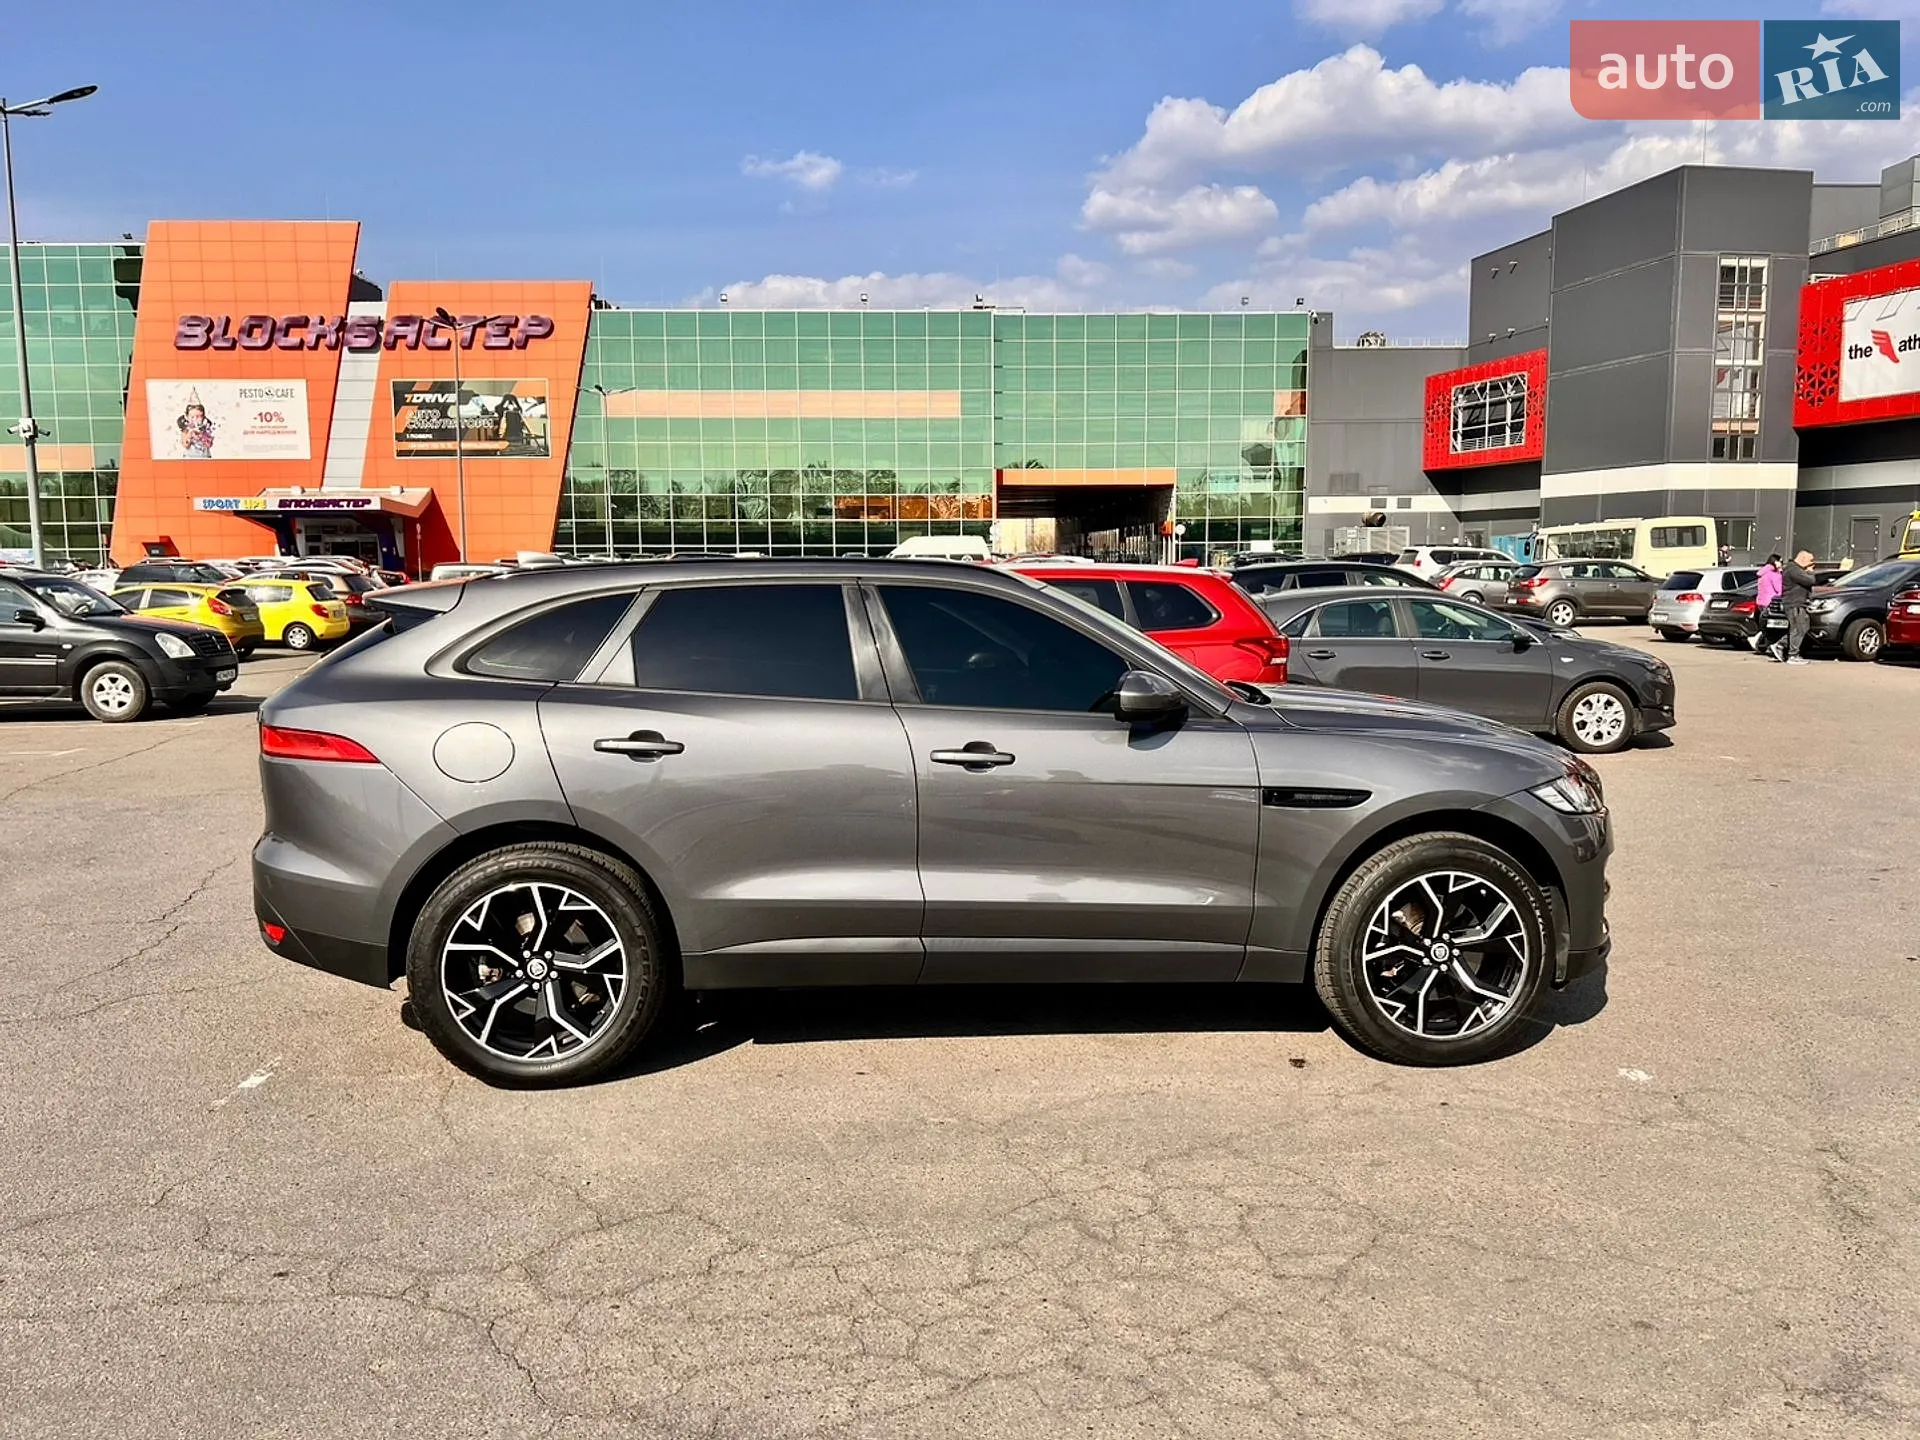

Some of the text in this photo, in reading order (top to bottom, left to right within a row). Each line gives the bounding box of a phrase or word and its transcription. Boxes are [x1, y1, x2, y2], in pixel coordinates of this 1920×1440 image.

[1848, 343, 1873, 360] the
[239, 388, 295, 399] PESTO CAFE
[253, 411, 285, 423] -10%
[202, 499, 267, 510] SPORT LIFE
